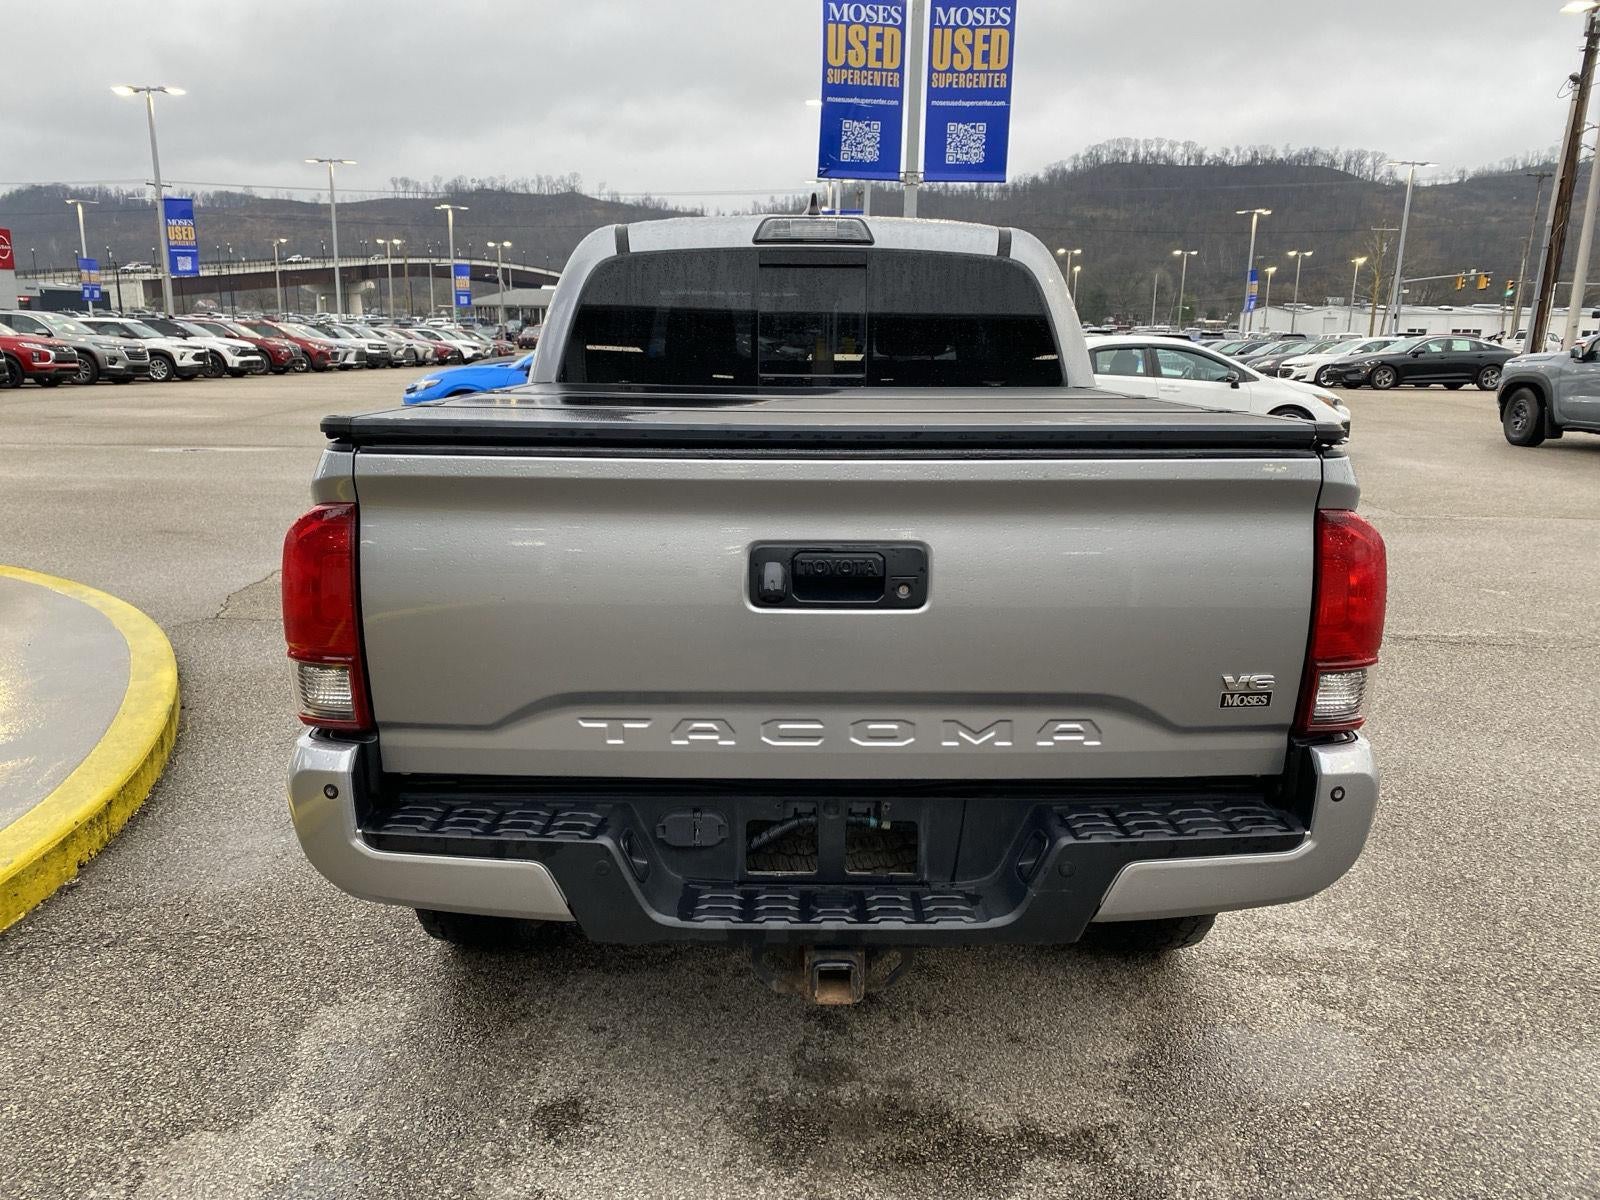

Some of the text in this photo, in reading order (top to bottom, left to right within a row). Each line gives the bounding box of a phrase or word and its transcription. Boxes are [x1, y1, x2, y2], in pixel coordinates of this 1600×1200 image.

[828, 3, 902, 25] MOSES
[934, 6, 1011, 26] MOSES
[827, 23, 901, 69] USED
[932, 28, 1010, 71] USED
[827, 69, 900, 87] SUPERCENTER
[931, 73, 1007, 89] SUPERCENTER
[826, 96, 899, 106] mosesusedsupercenter.com
[931, 100, 1006, 108] mosesusedsupercenter.com
[168, 226, 195, 240] USED
[800, 559, 879, 576] TOYOTA
[1222, 672, 1275, 690] V6
[1223, 694, 1267, 707] MOSES
[578, 717, 1102, 747] TACOMA
